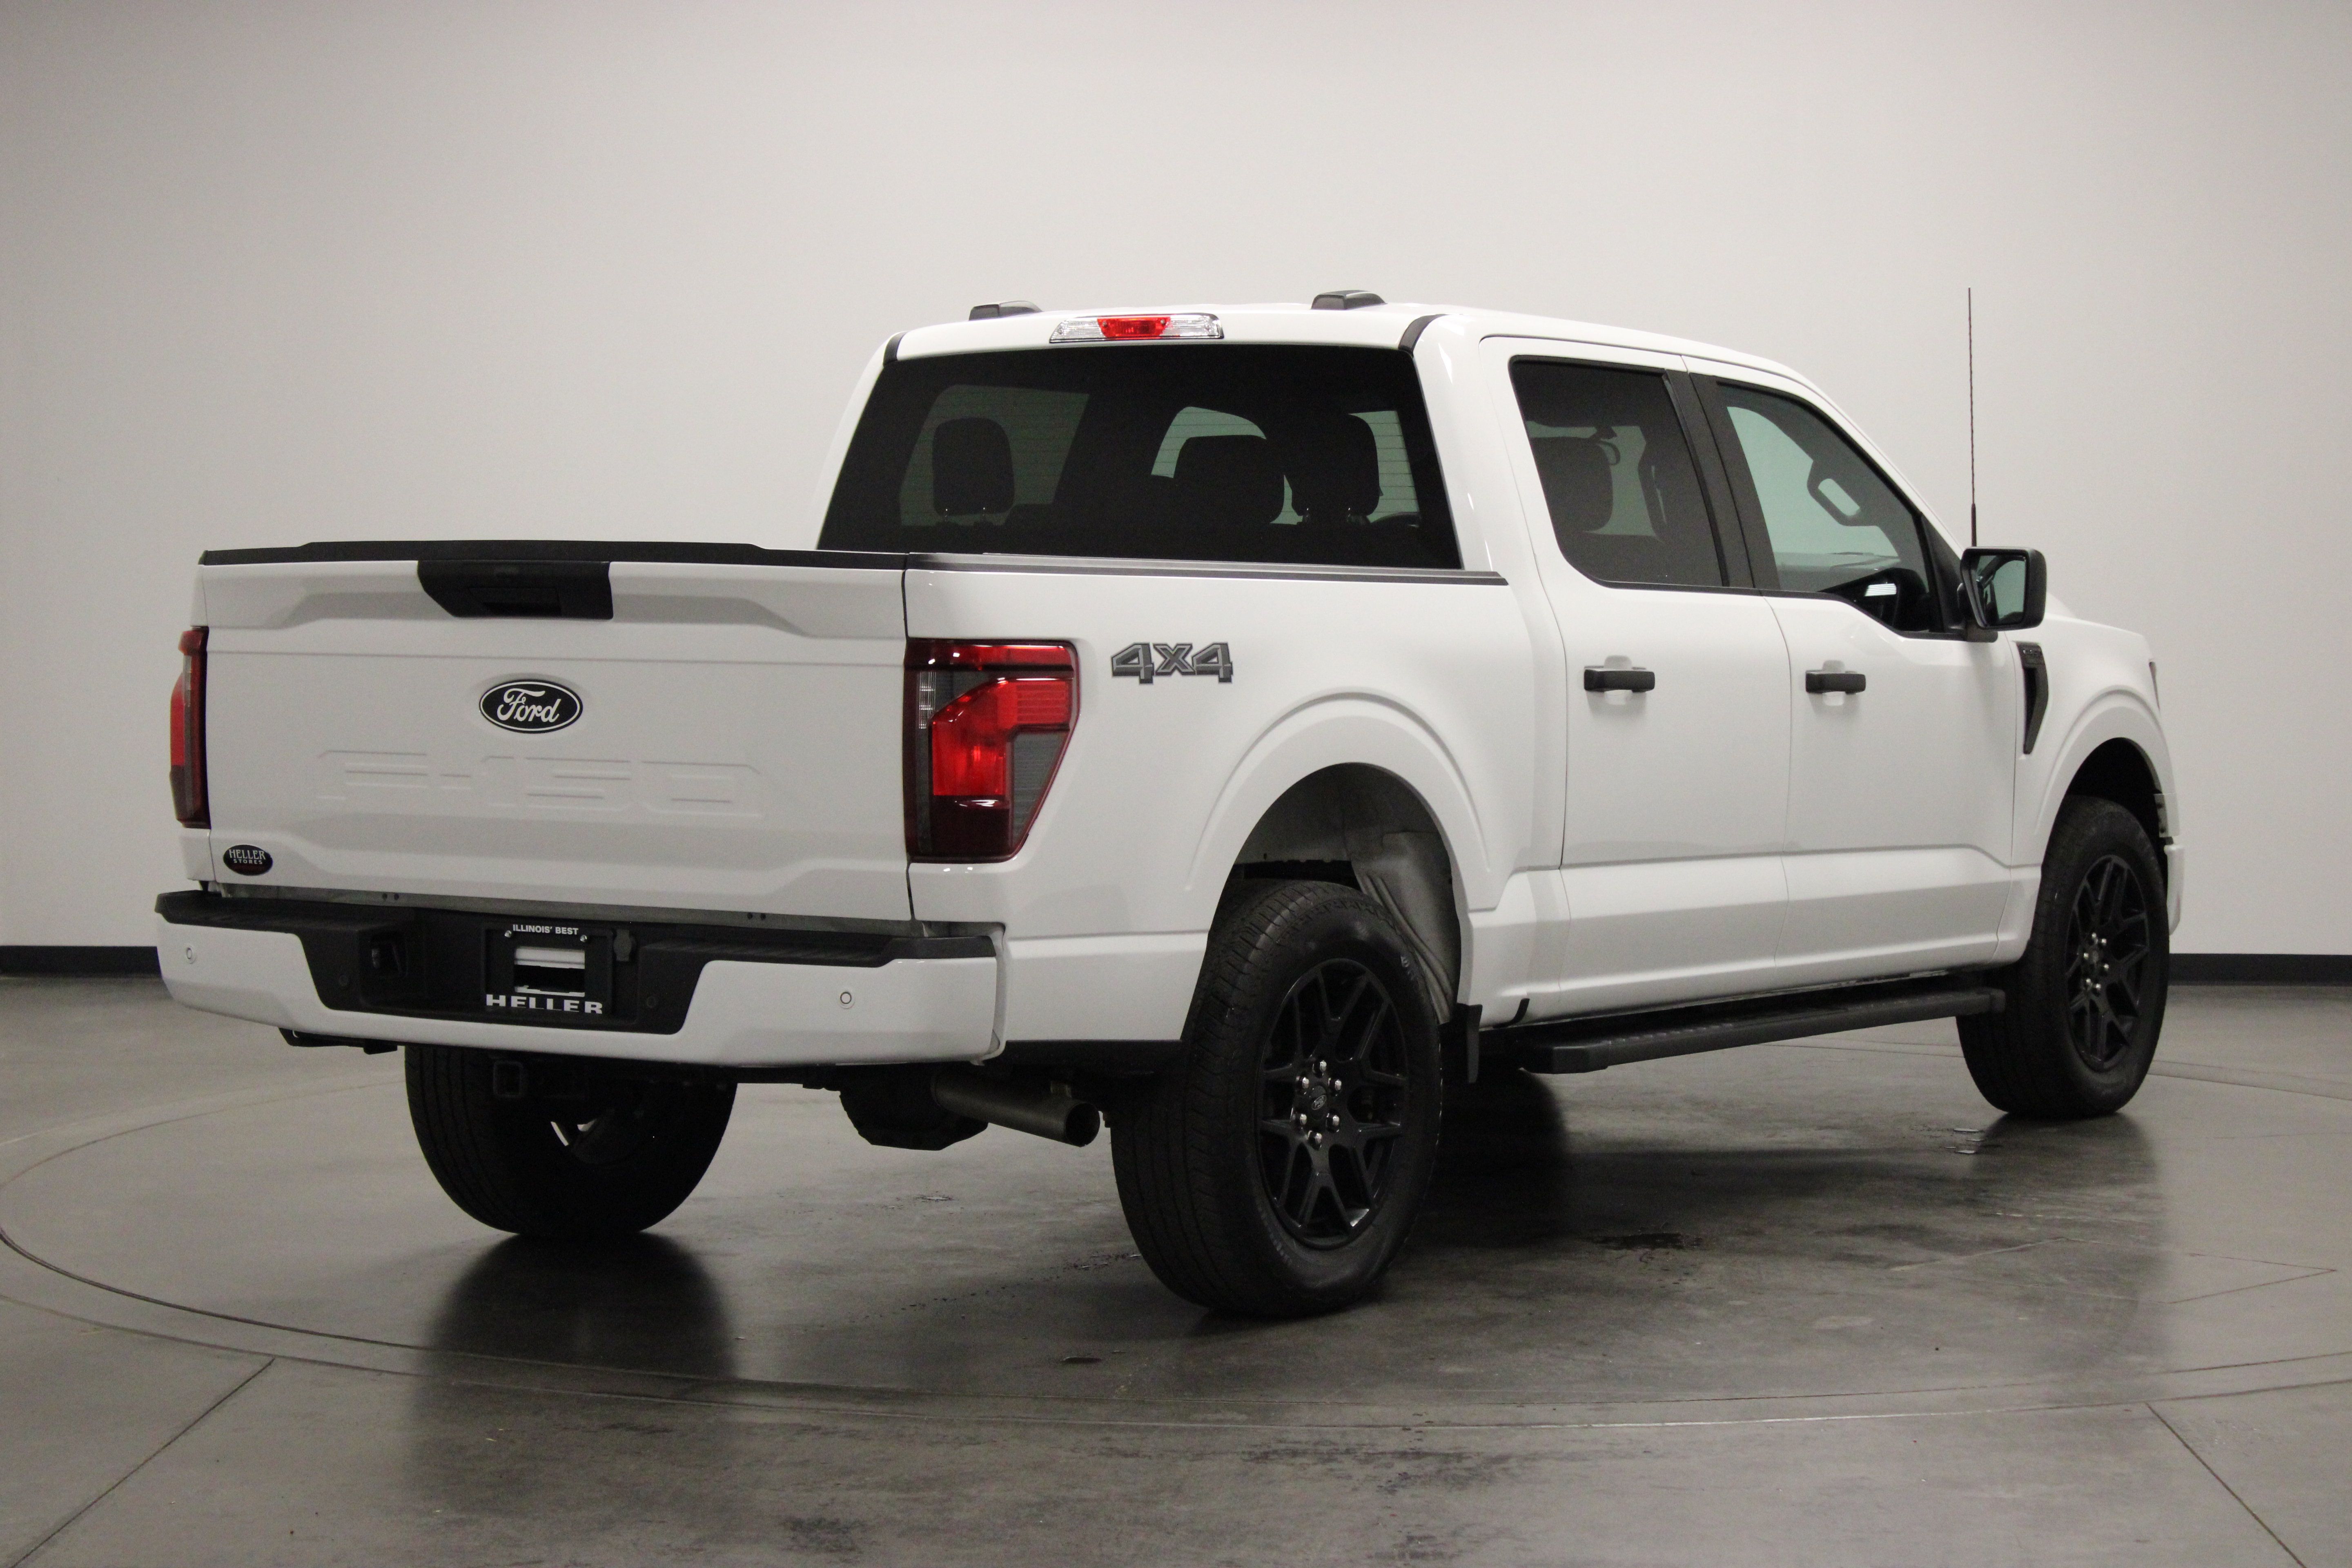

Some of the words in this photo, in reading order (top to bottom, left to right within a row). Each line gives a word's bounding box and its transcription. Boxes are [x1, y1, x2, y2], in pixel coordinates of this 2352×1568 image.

[497, 688, 561, 722] Ford
[316, 750, 764, 817] F-150
[229, 849, 266, 860] HELLER
[486, 994, 602, 1014] HELLER
